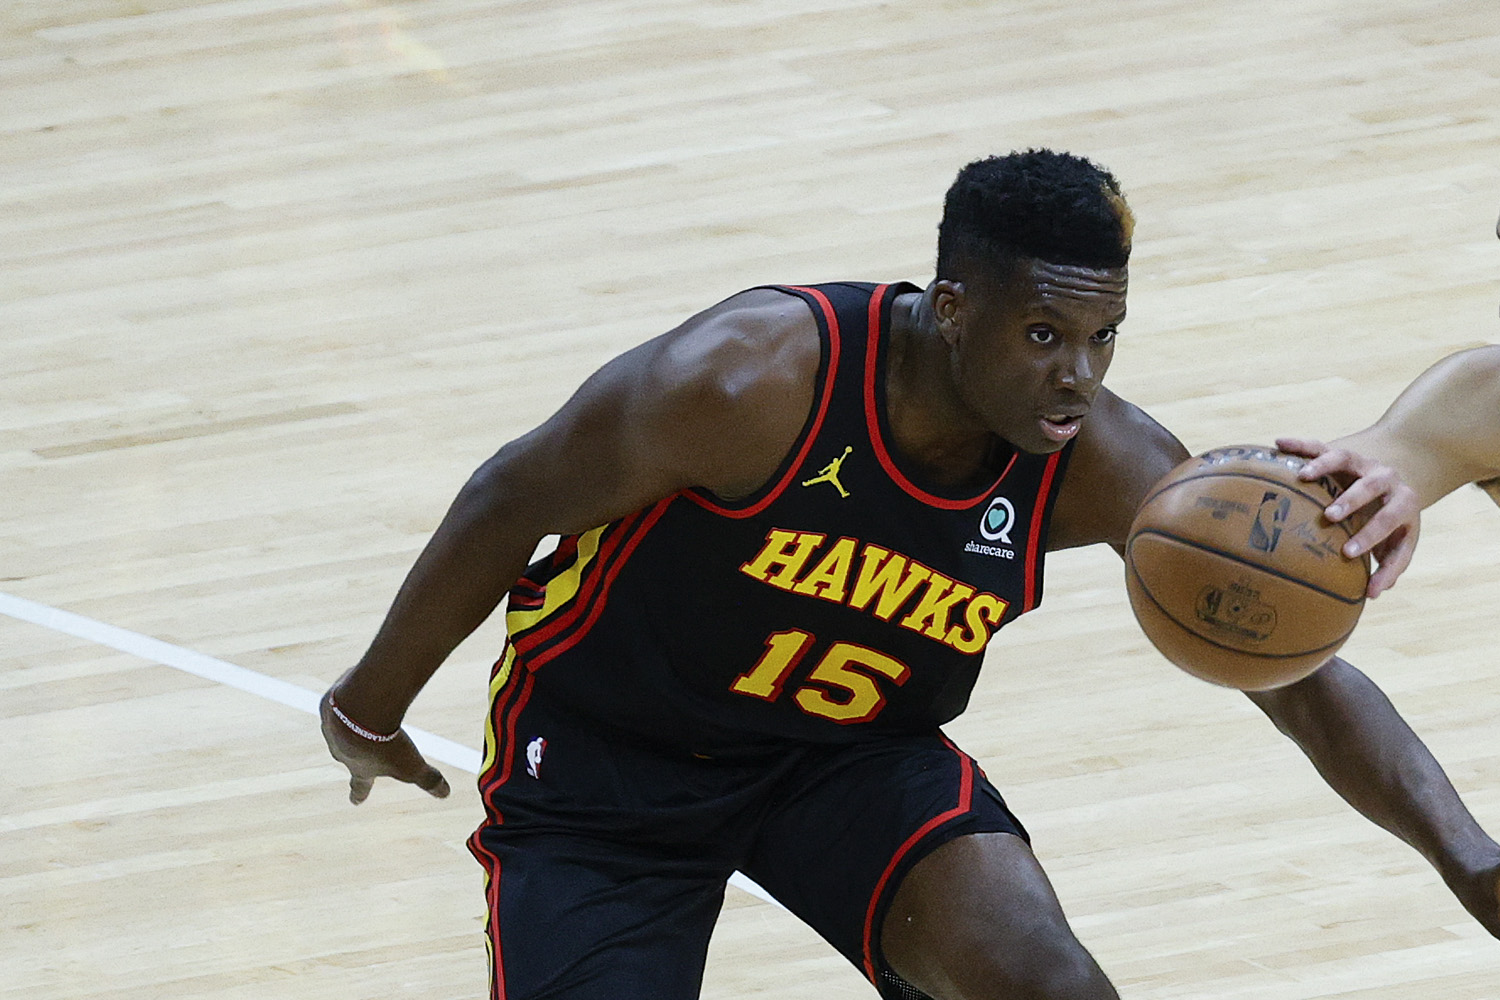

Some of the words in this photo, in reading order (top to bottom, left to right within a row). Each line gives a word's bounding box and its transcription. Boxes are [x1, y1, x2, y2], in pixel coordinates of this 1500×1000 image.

[739, 527, 1010, 655] HAWKS
[964, 540, 1015, 560] sharecare
[728, 627, 911, 725] 15
